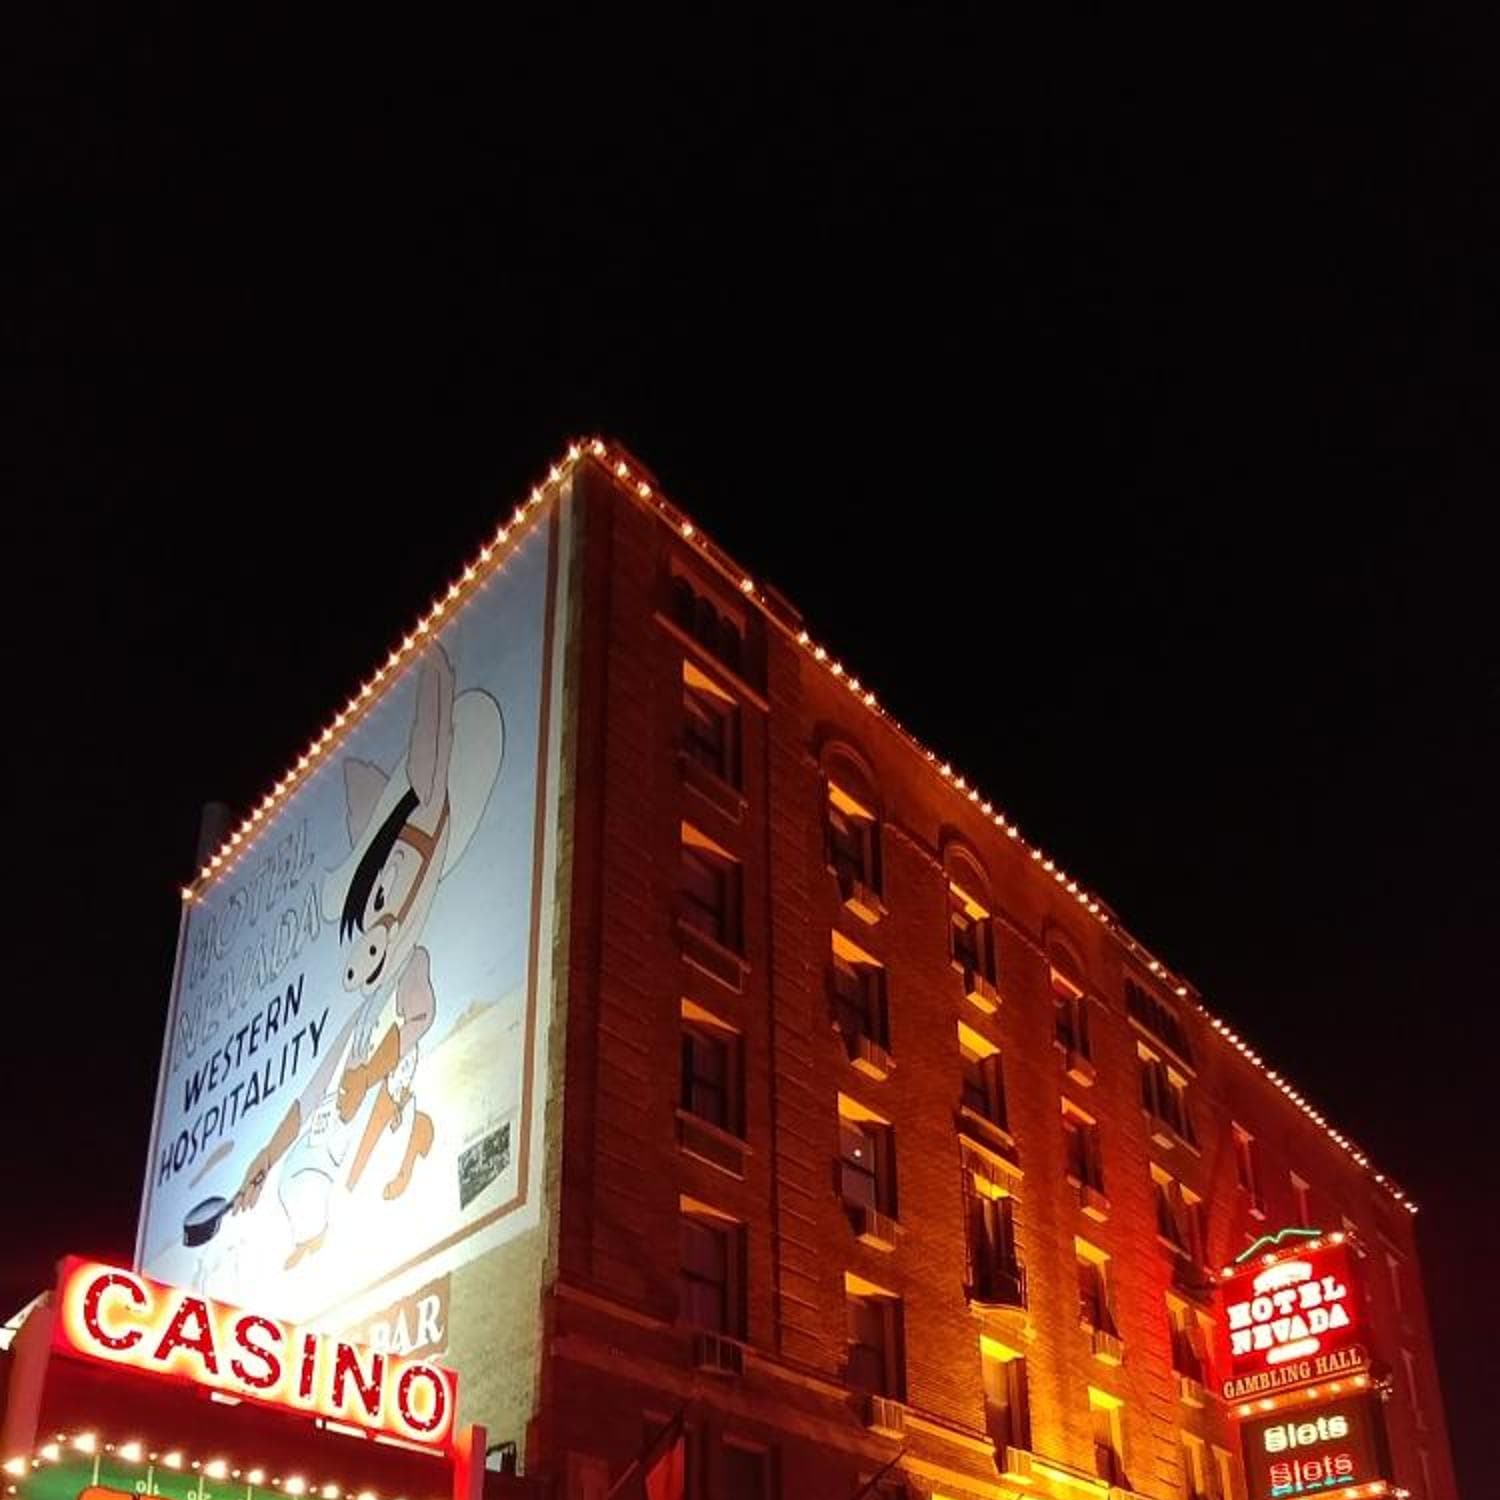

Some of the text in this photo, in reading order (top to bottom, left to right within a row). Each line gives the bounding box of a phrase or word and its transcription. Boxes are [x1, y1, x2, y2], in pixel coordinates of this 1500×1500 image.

[183, 973, 305, 1114] WESTERN
[158, 1007, 329, 1187] HOSPITALITY
[371, 1295, 445, 1354] BAR
[1227, 1276, 1347, 1330] HOTEL
[1230, 1303, 1350, 1356] NEVADA
[82, 1272, 445, 1432] CASINO
[1223, 1348, 1361, 1399] GAMBLING HALL
[1264, 1415, 1349, 1453] Slots
[1270, 1453, 1354, 1487] Slots
